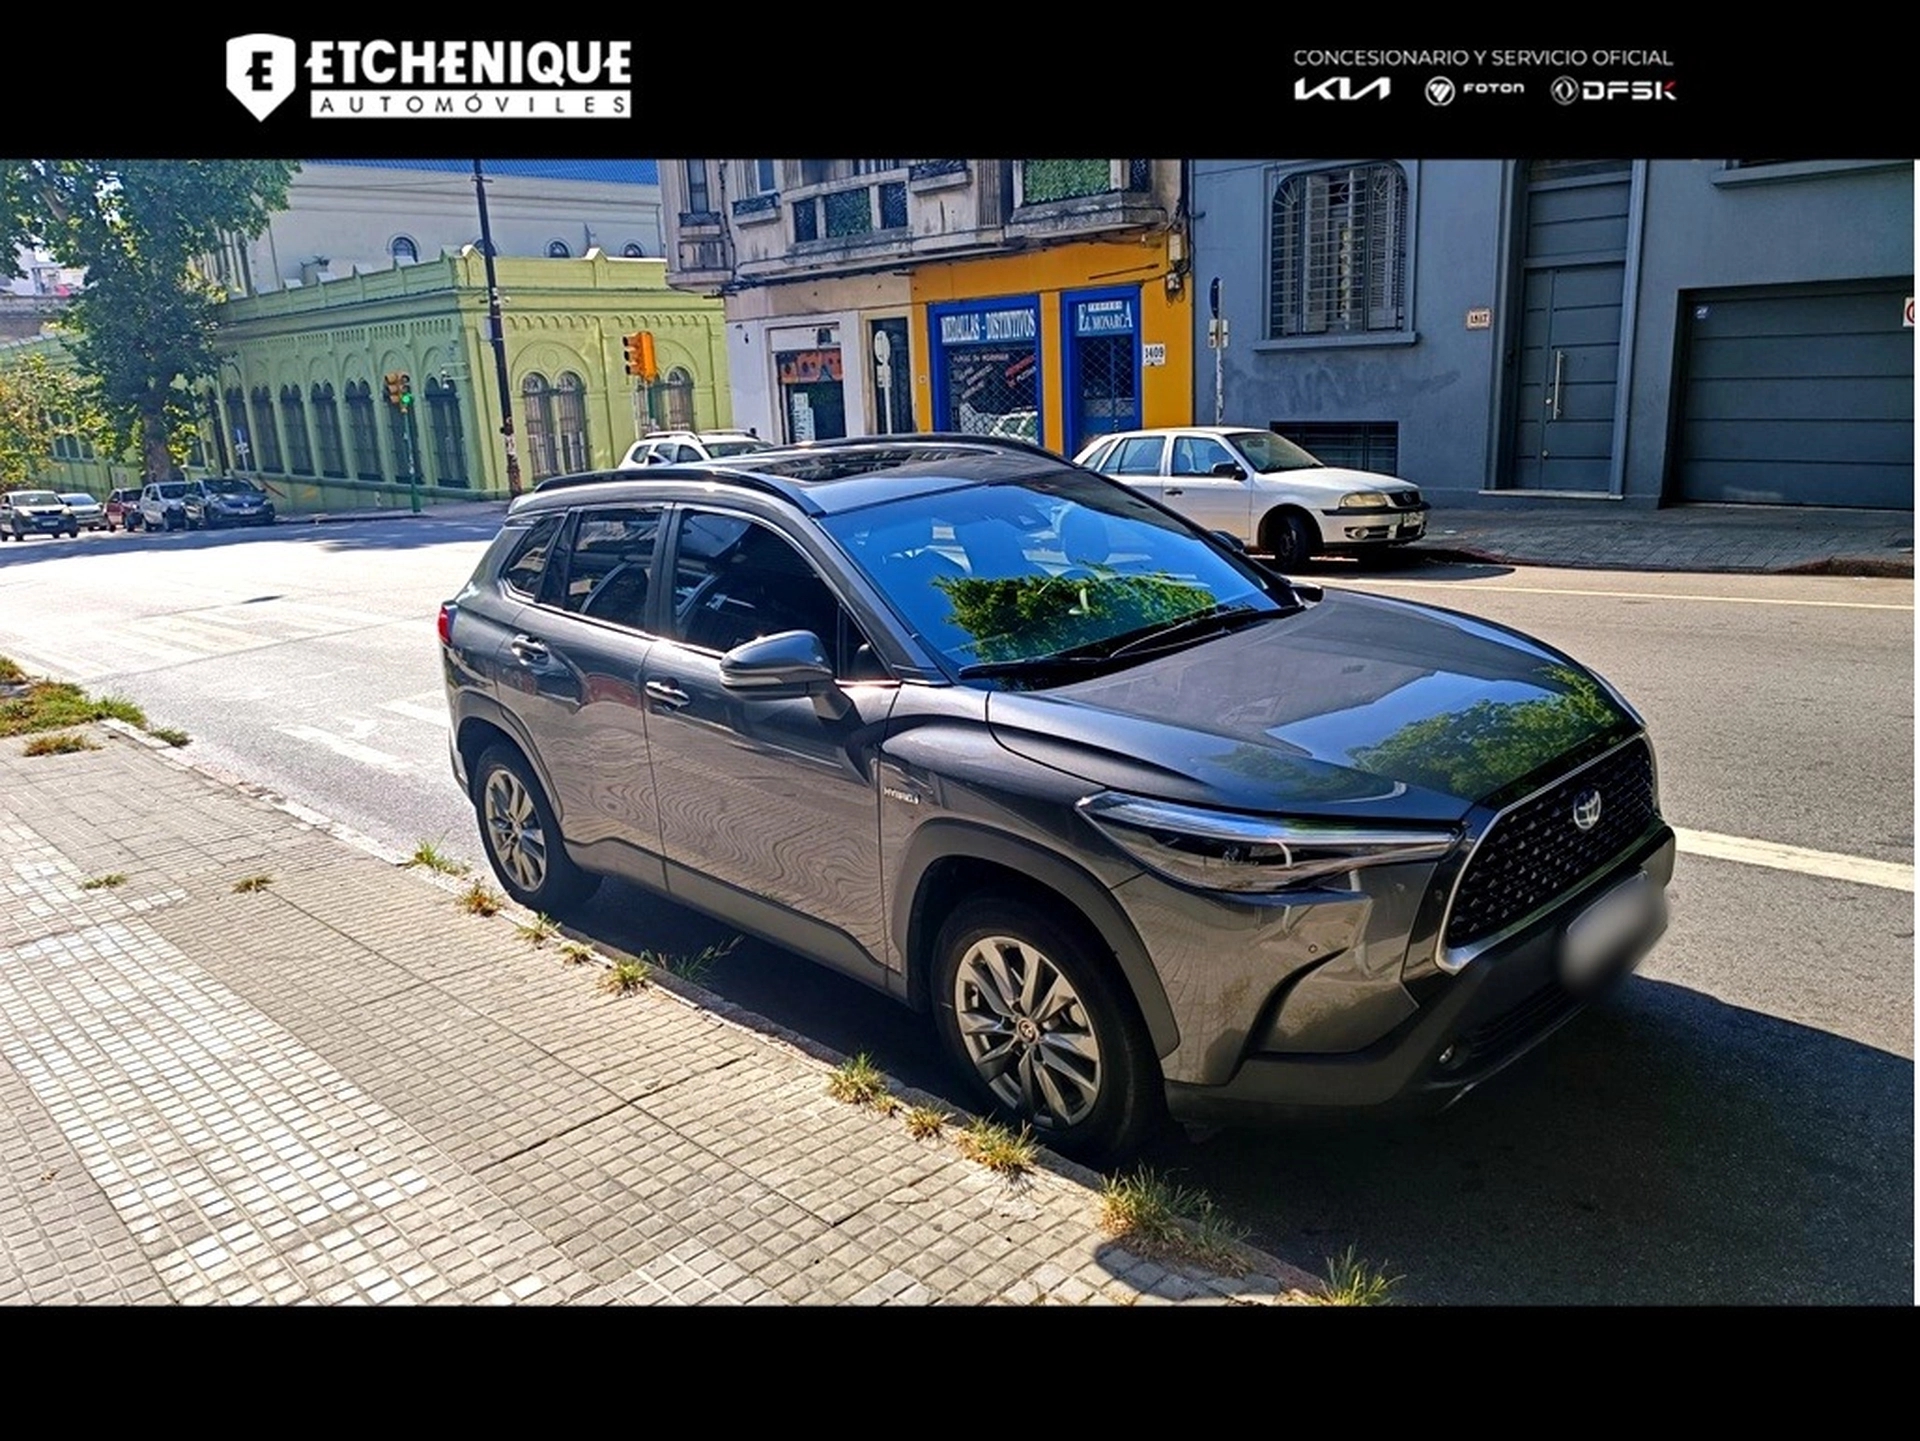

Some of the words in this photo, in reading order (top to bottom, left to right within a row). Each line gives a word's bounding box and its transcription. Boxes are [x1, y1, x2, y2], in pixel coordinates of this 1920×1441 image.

[940, 313, 980, 343] MEDALLAS
[985, 308, 1036, 340] DISTINTIVOS
[1145, 346, 1164, 359] 1409
